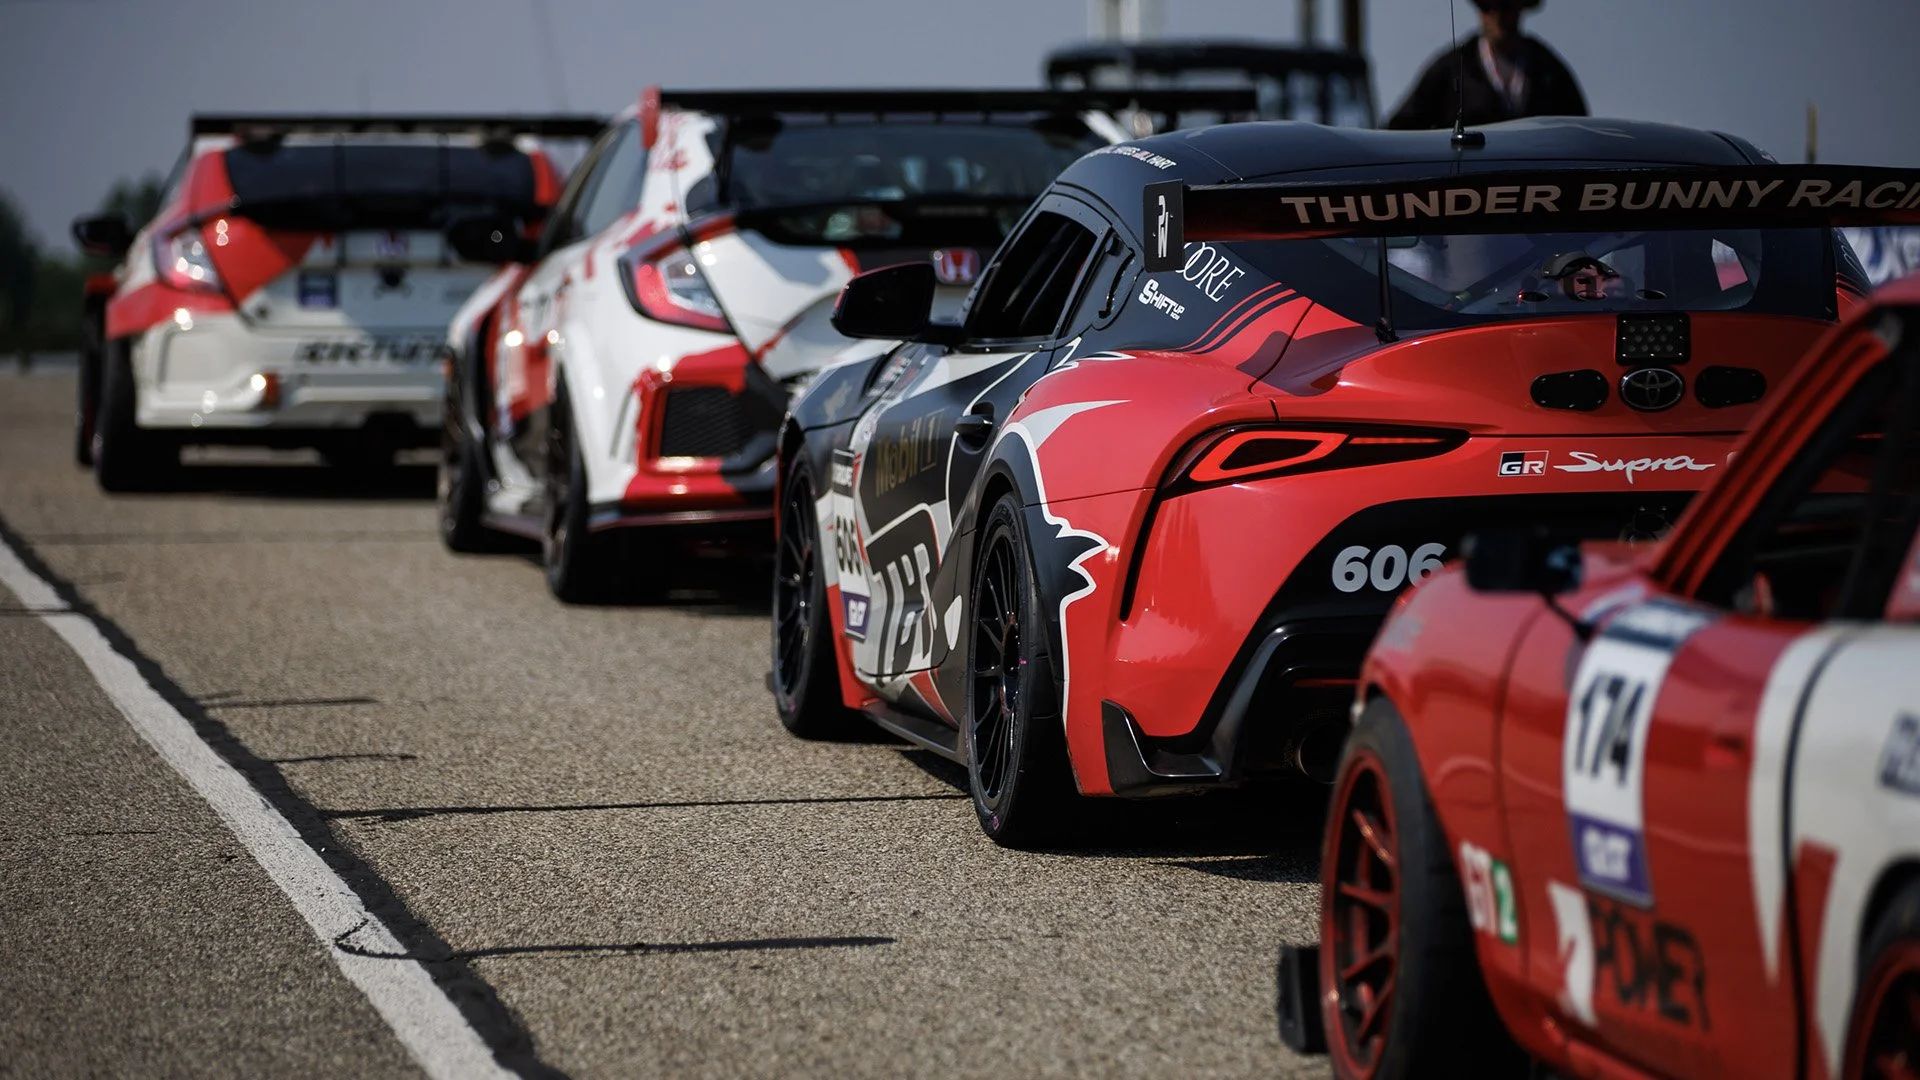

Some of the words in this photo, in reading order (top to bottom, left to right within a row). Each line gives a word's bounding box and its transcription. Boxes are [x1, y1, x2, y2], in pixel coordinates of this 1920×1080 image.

[1281, 186, 1561, 223] THUNDER
[1578, 179, 1784, 212] BUNNY
[876, 416, 921, 498] Mobil
[1500, 460, 1545, 476] GR
[1552, 451, 1717, 485] Supra
[1331, 542, 1448, 593] 606
